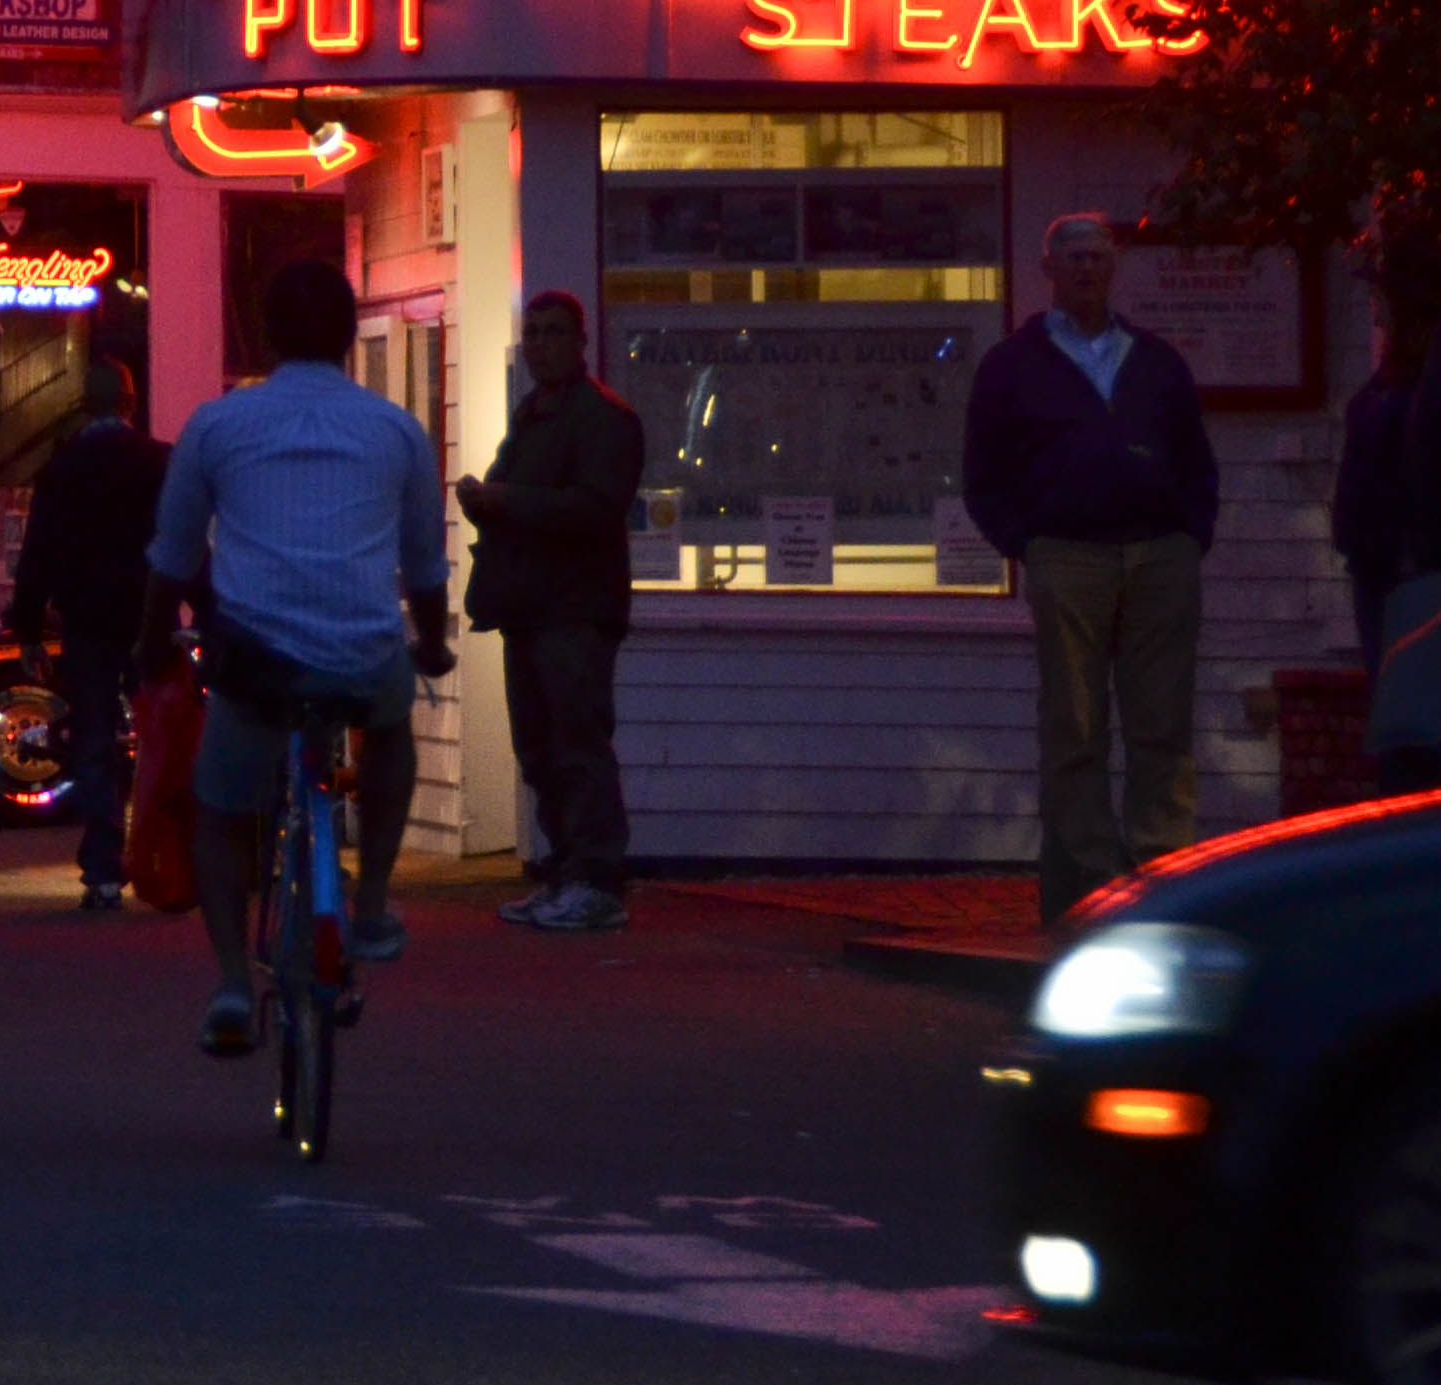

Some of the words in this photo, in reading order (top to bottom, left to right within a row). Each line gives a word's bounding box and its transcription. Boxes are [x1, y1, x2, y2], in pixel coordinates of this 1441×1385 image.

[3, 25, 58, 39] LEATHER
[62, 26, 109, 40] DESIGN
[18, 286, 53, 306] ON
